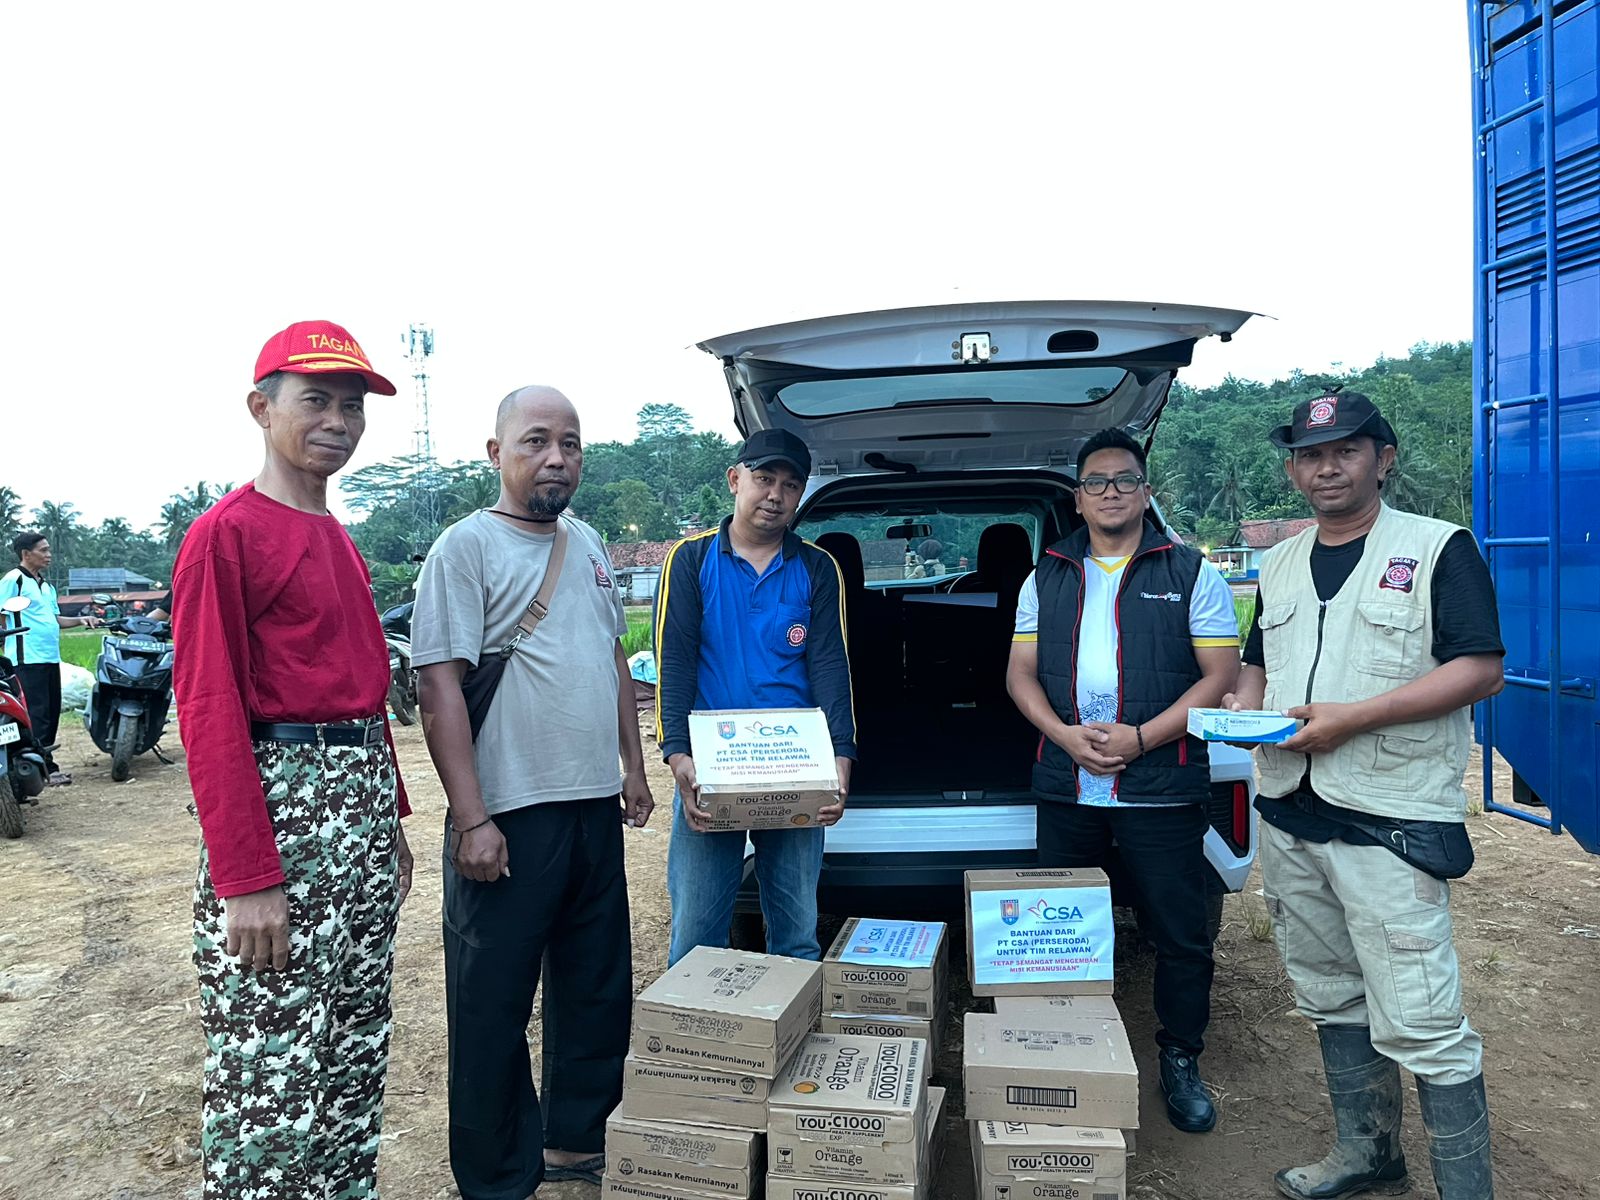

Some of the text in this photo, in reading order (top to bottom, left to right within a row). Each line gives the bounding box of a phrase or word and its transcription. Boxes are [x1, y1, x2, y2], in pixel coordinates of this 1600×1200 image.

[0, 725, 15, 736] MN
[759, 725, 799, 737] CSA
[748, 808, 793, 818] Orange
[1043, 906, 1084, 921] CSA
[1010, 928, 1076, 937] BANTUAN DARI
[1031, 937, 1090, 946] (PERSERODA)
[996, 948, 1027, 956] UNTUK
[1048, 946, 1091, 954] RELAWAN
[860, 995, 897, 1006] Orange
[665, 1045, 700, 1057] Rasakan
[826, 1047, 860, 1090] Orange
[853, 1057, 869, 1082] Vitamin
[700, 1075, 737, 1086] Rasakan
[826, 1146, 854, 1154] Vitamin
[815, 1150, 863, 1166] Orange
[637, 1166, 675, 1179] Rasakan
[1033, 1187, 1080, 1198] Orange
